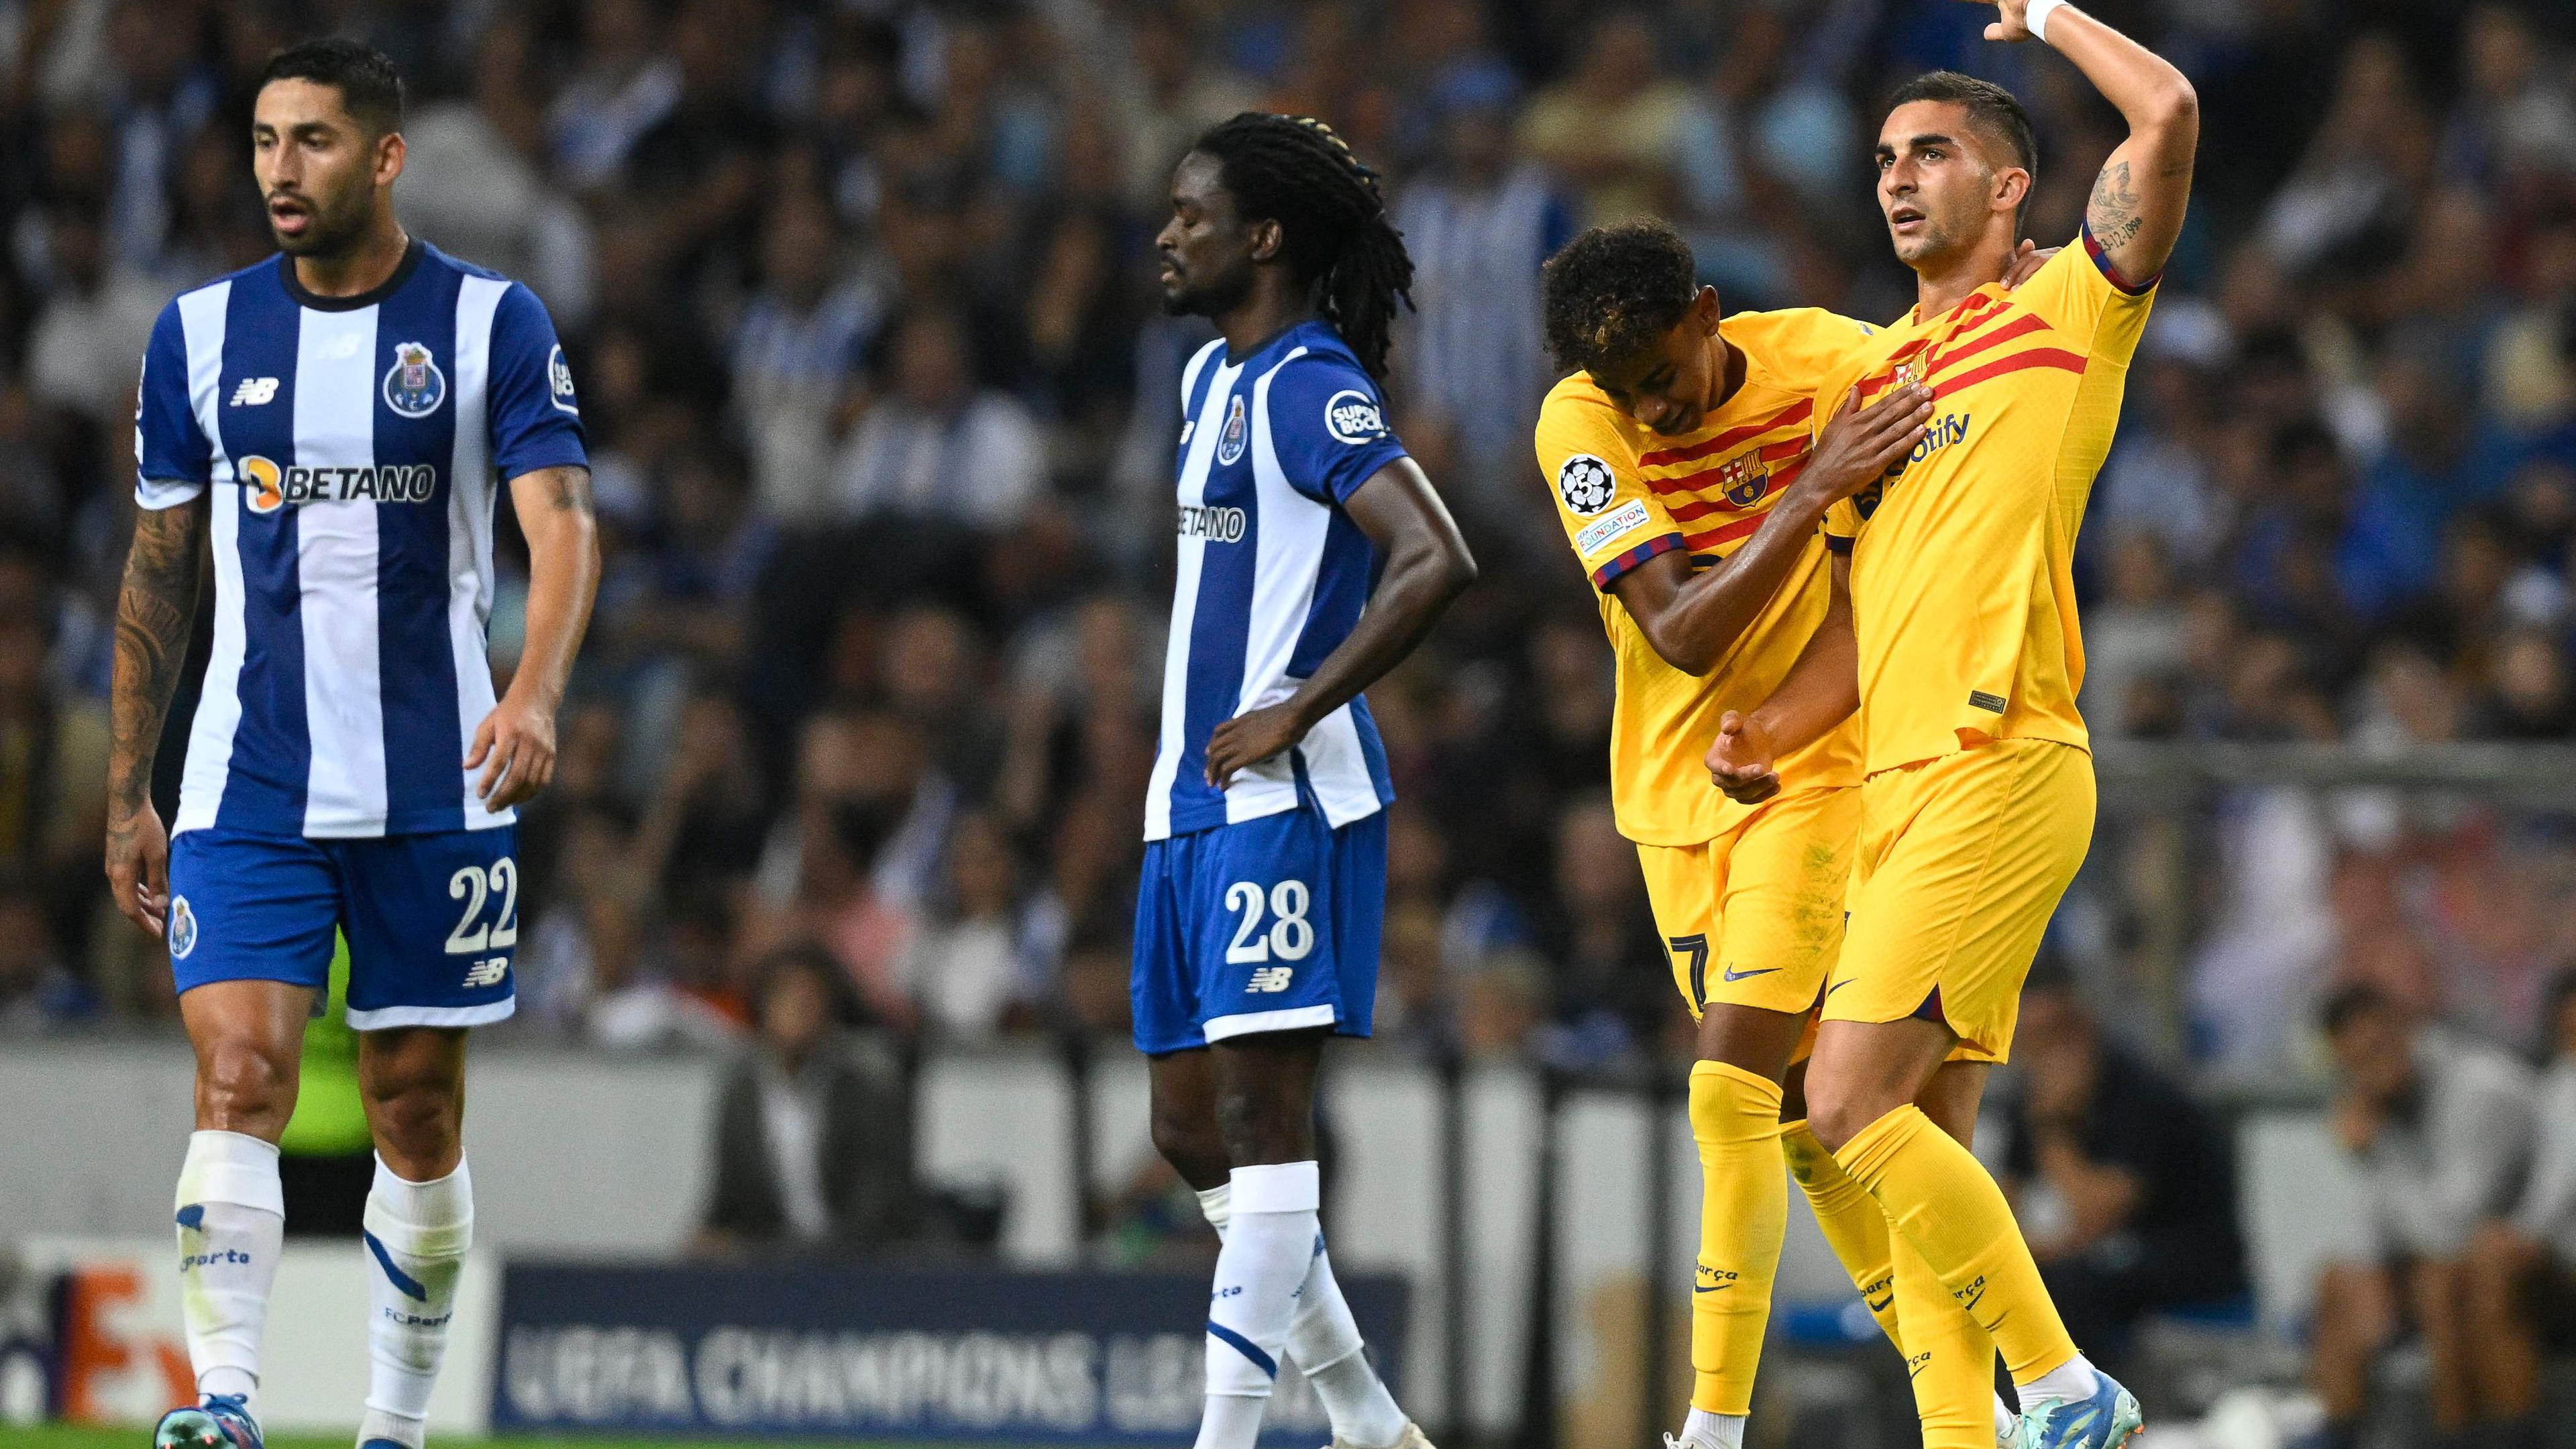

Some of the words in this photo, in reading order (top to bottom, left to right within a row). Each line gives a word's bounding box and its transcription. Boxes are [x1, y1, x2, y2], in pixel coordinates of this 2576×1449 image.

[1911, 413, 1971, 463] otify
[283, 464, 435, 502] BETANO
[1576, 472, 1594, 498] 5
[1178, 506, 1246, 543] ETANO
[1580, 507, 1645, 549] FOUNDATION
[444, 856, 517, 954] 22
[1225, 879, 1315, 965] 28
[1668, 933, 1709, 1014] 7
[506, 1324, 688, 1421] UEFA
[694, 1326, 1097, 1432] CHAMPIONS
